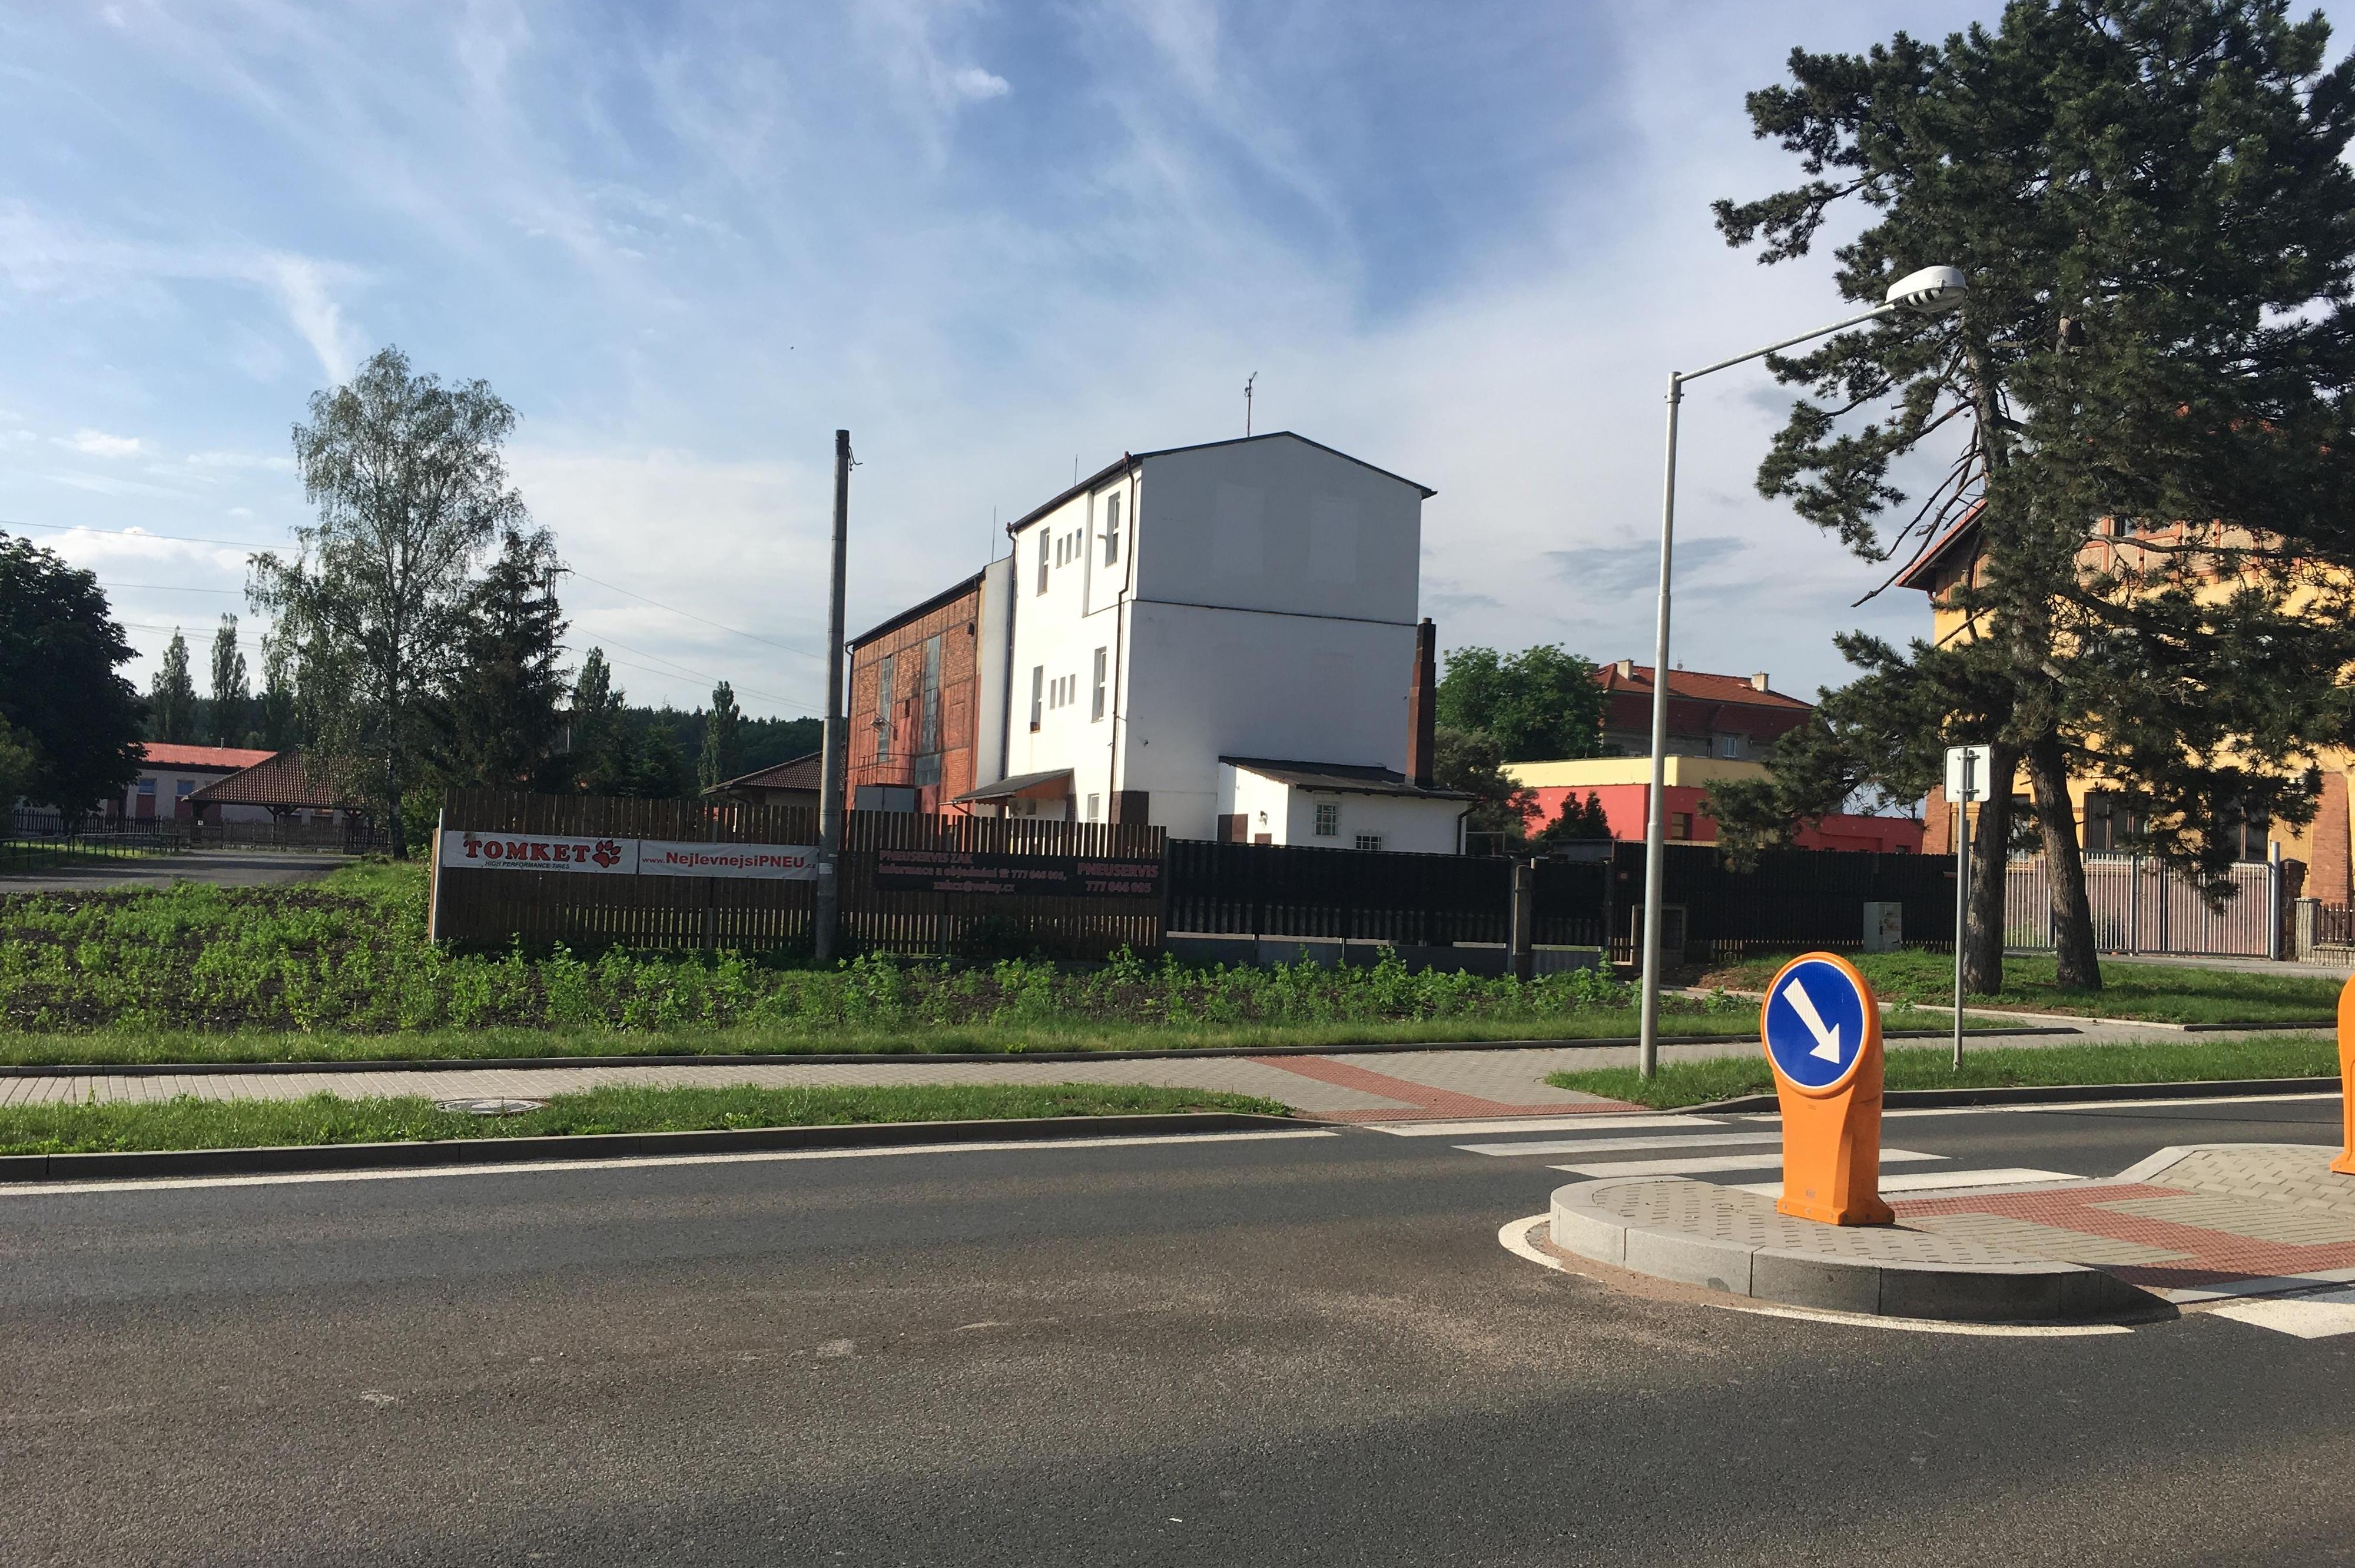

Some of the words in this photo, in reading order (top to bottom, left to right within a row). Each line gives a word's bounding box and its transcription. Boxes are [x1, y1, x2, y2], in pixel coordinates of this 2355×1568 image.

[463, 840, 590, 862] TOMKET
[879, 850, 950, 863] PNEUSERVIS
[642, 852, 816, 869] www.NejlevnejsiPNEU.cz
[1011, 869, 1029, 879] 777
[1077, 862, 1159, 878] PNEUSERVIS
[1085, 881, 1107, 892] 777
[1107, 881, 1130, 892] 046
